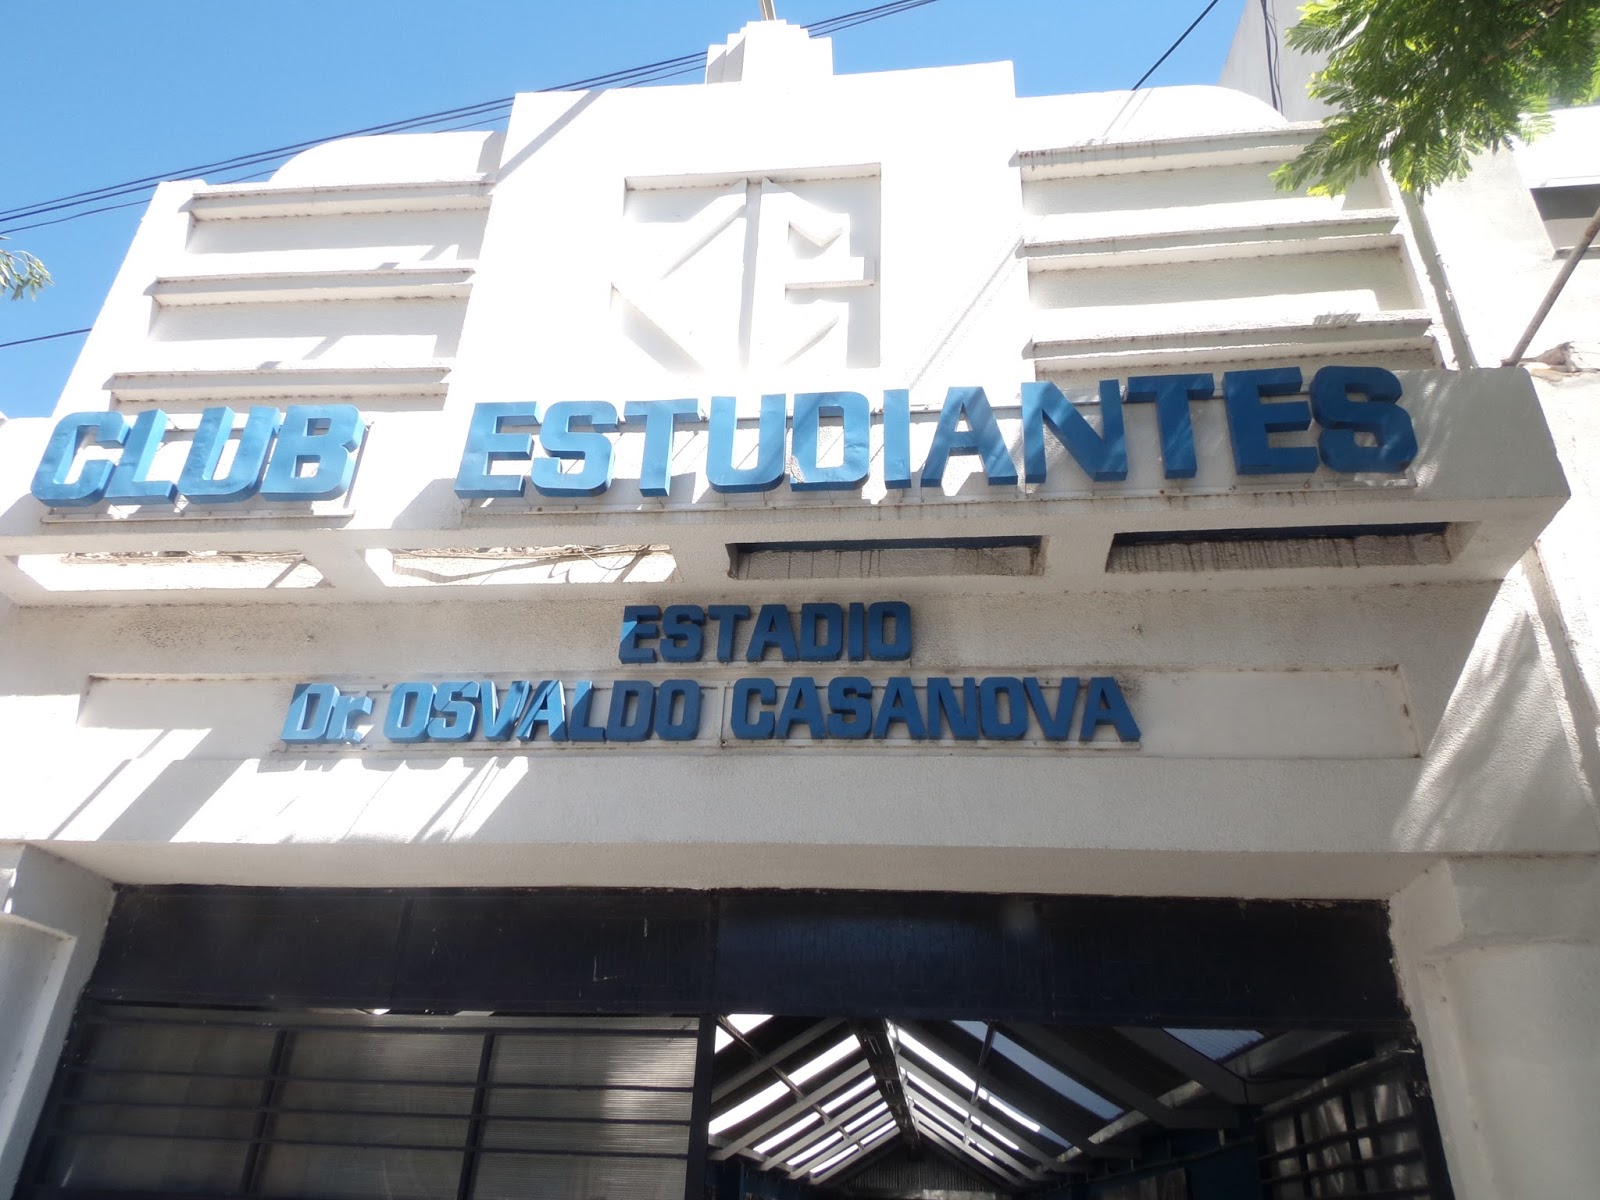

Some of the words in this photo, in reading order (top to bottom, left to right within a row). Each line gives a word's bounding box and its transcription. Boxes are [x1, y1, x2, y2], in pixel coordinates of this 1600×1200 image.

[30, 404, 366, 505] CLUB
[454, 365, 1416, 499] ESTUDIANTES
[619, 602, 912, 663] ESTADIO
[383, 680, 701, 743] OSVALDO
[731, 676, 1141, 742] CASANOVA
